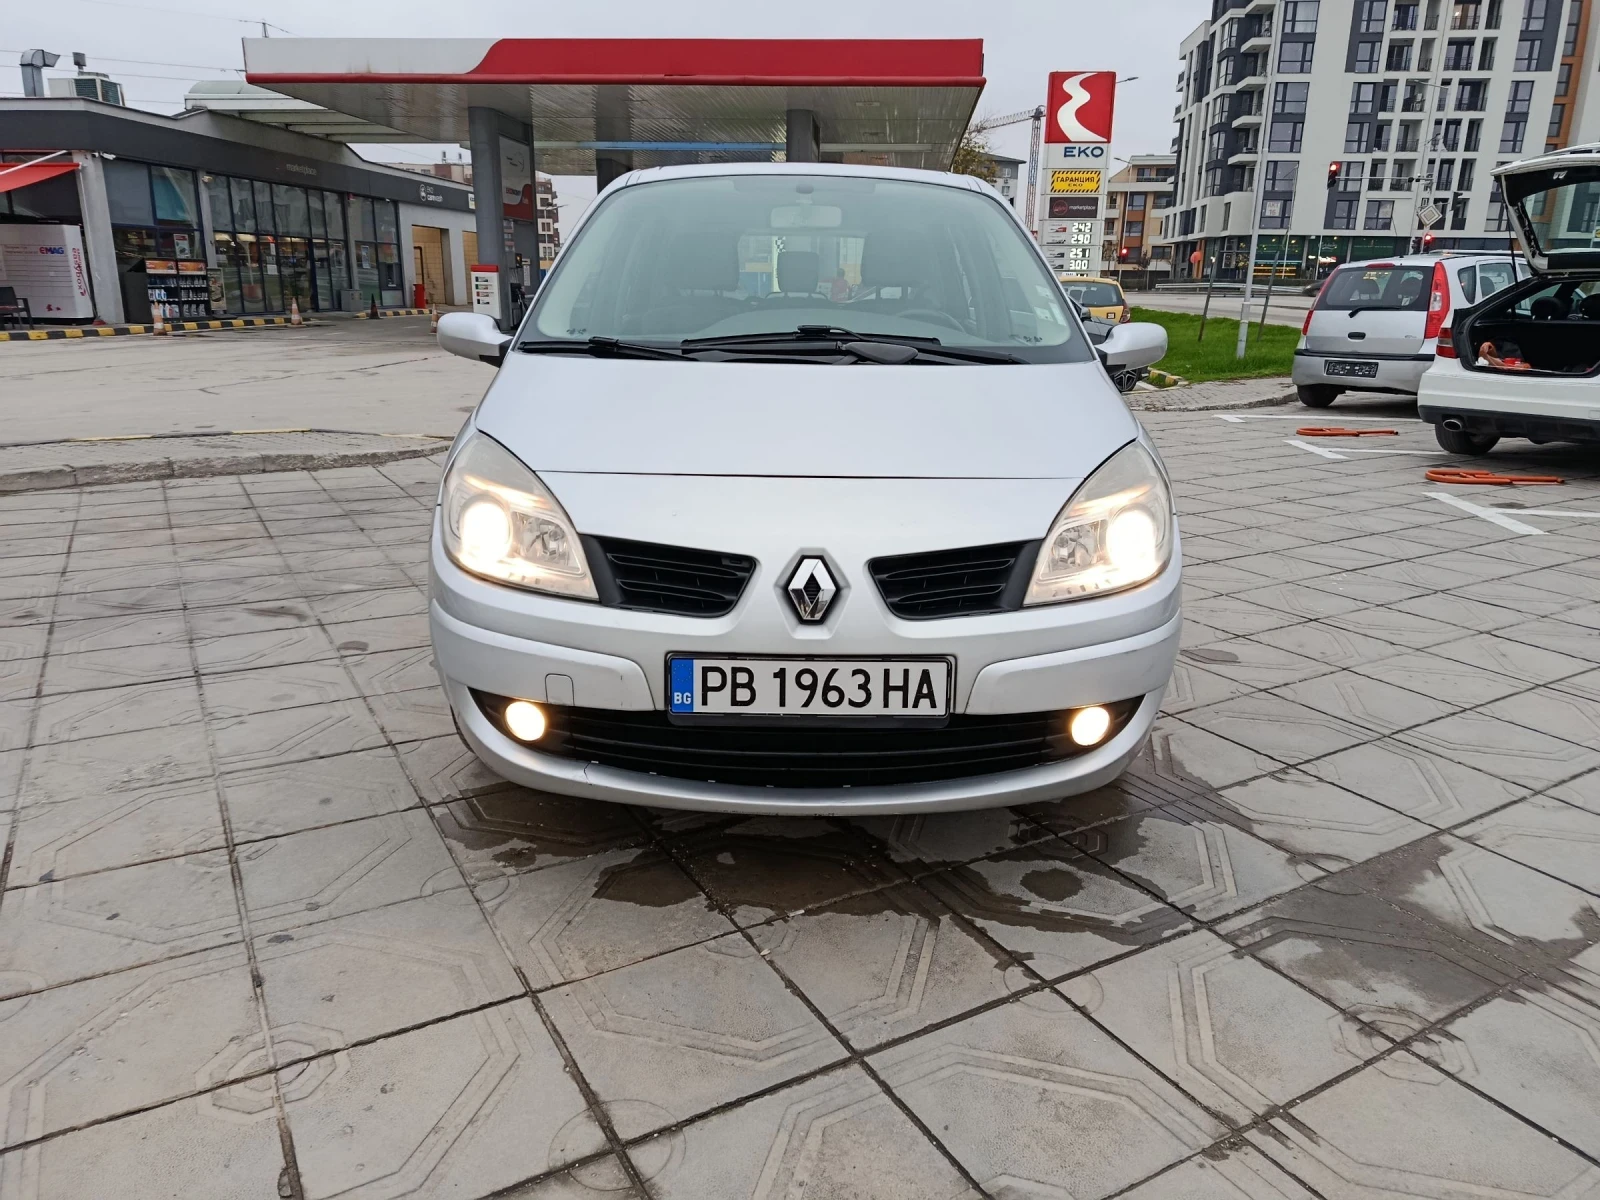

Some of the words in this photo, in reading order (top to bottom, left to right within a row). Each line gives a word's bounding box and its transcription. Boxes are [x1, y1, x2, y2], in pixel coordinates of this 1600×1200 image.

[1063, 146, 1104, 158] EKO
[1072, 222, 1091, 233] 242
[1071, 234, 1090, 244] 290
[1069, 248, 1089, 258] 251
[1069, 260, 1088, 270] 300
[701, 666, 757, 707] PB
[773, 667, 872, 708] 1963
[883, 668, 937, 709] HA
[673, 692, 692, 704] BG
